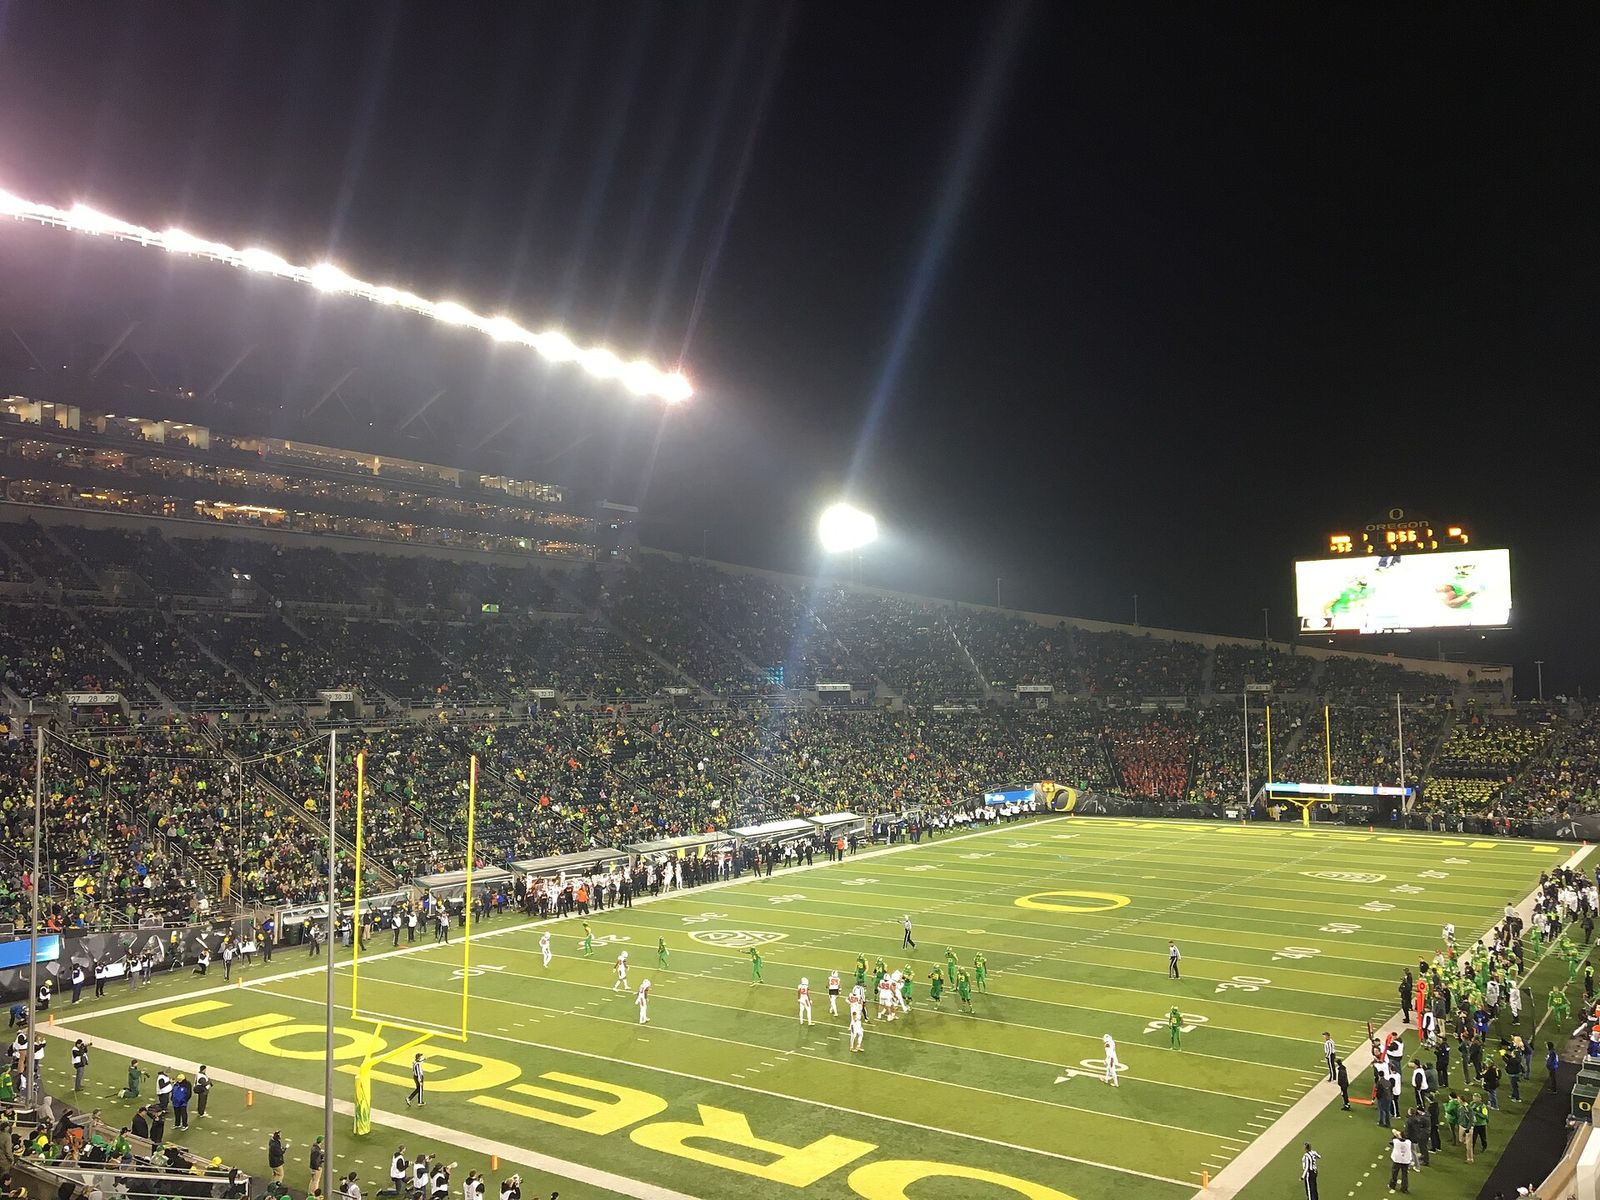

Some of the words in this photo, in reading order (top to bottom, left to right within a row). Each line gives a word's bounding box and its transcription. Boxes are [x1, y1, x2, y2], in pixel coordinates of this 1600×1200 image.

[1365, 520, 1429, 531] OREGON
[71, 695, 80, 703] 27
[1318, 922, 1362, 933] 50
[1275, 946, 1321, 959] 40
[1218, 975, 1272, 992] 30
[1148, 1012, 1209, 1033] 20
[1065, 1058, 1129, 1081] 10
